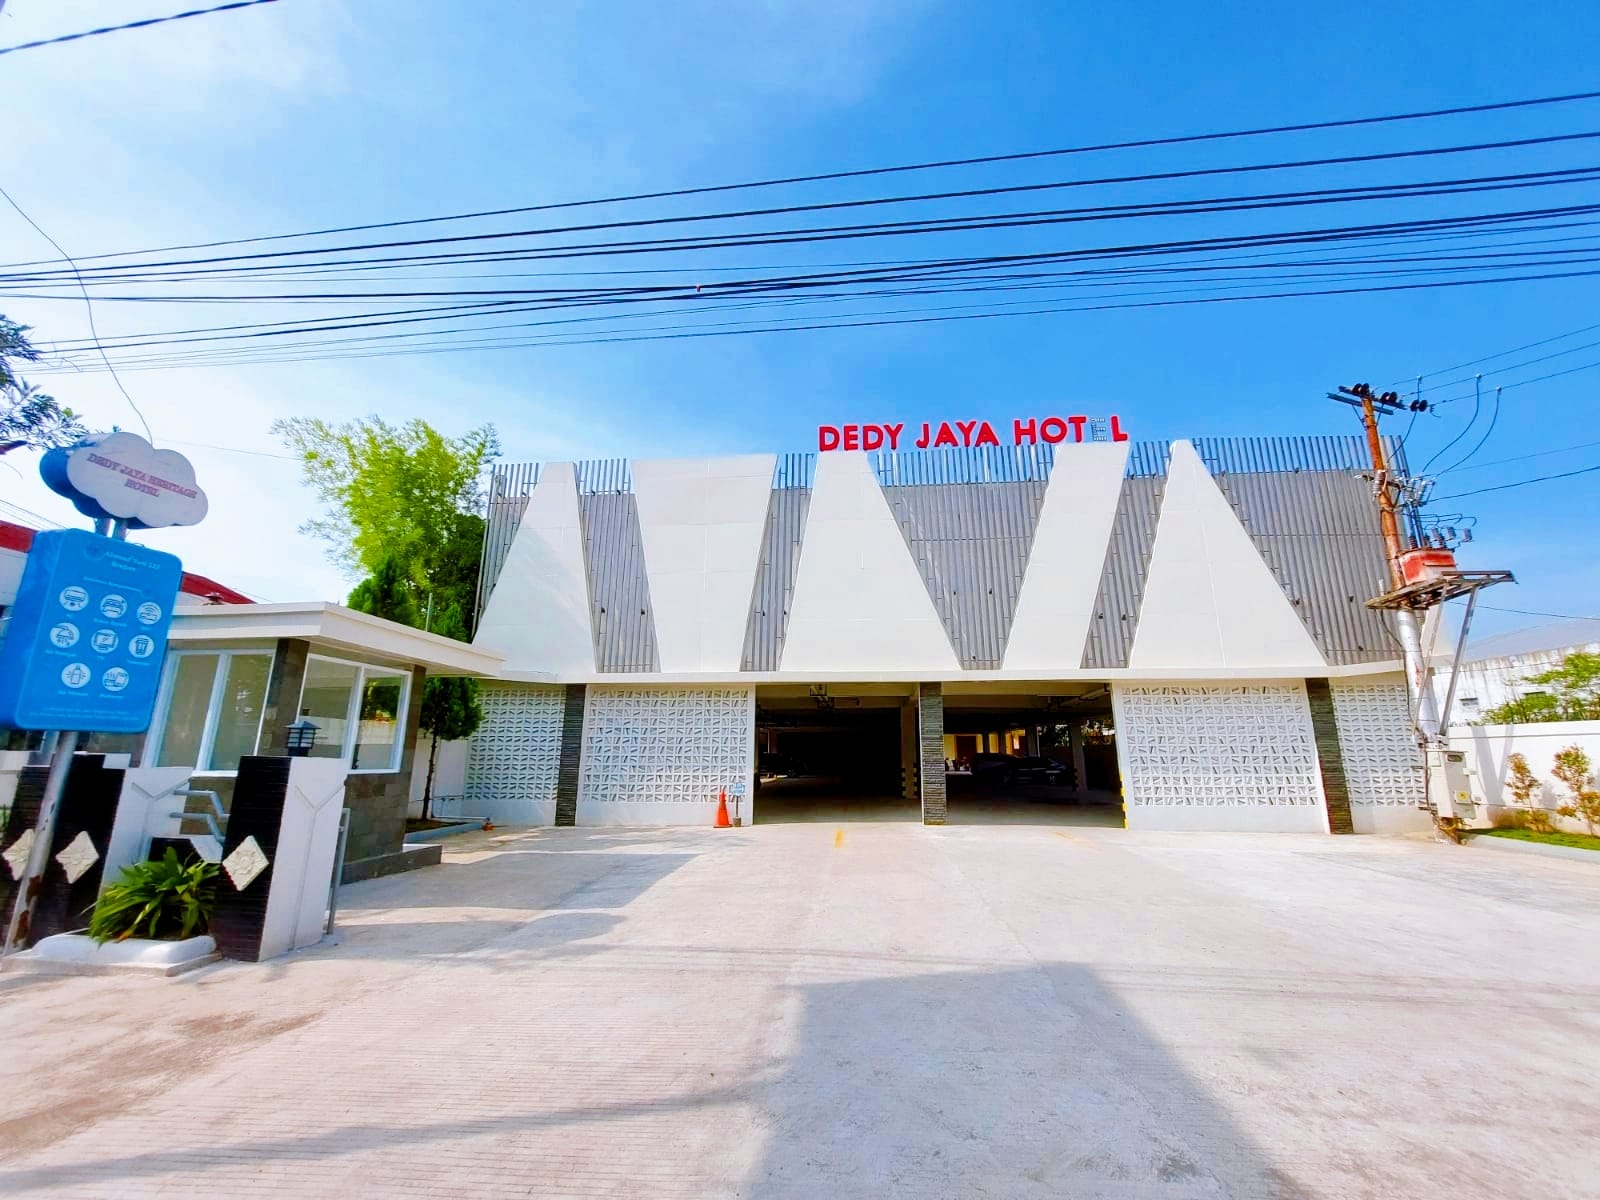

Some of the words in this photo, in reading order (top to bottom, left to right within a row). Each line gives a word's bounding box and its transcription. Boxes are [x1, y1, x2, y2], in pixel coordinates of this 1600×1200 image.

[818, 423, 904, 452] DEDY
[915, 421, 999, 448] JAYA
[1013, 415, 1128, 445] HOTEL
[86, 453, 122, 471] DEDY
[120, 466, 146, 482] JAYA
[124, 478, 161, 497] HOTEL
